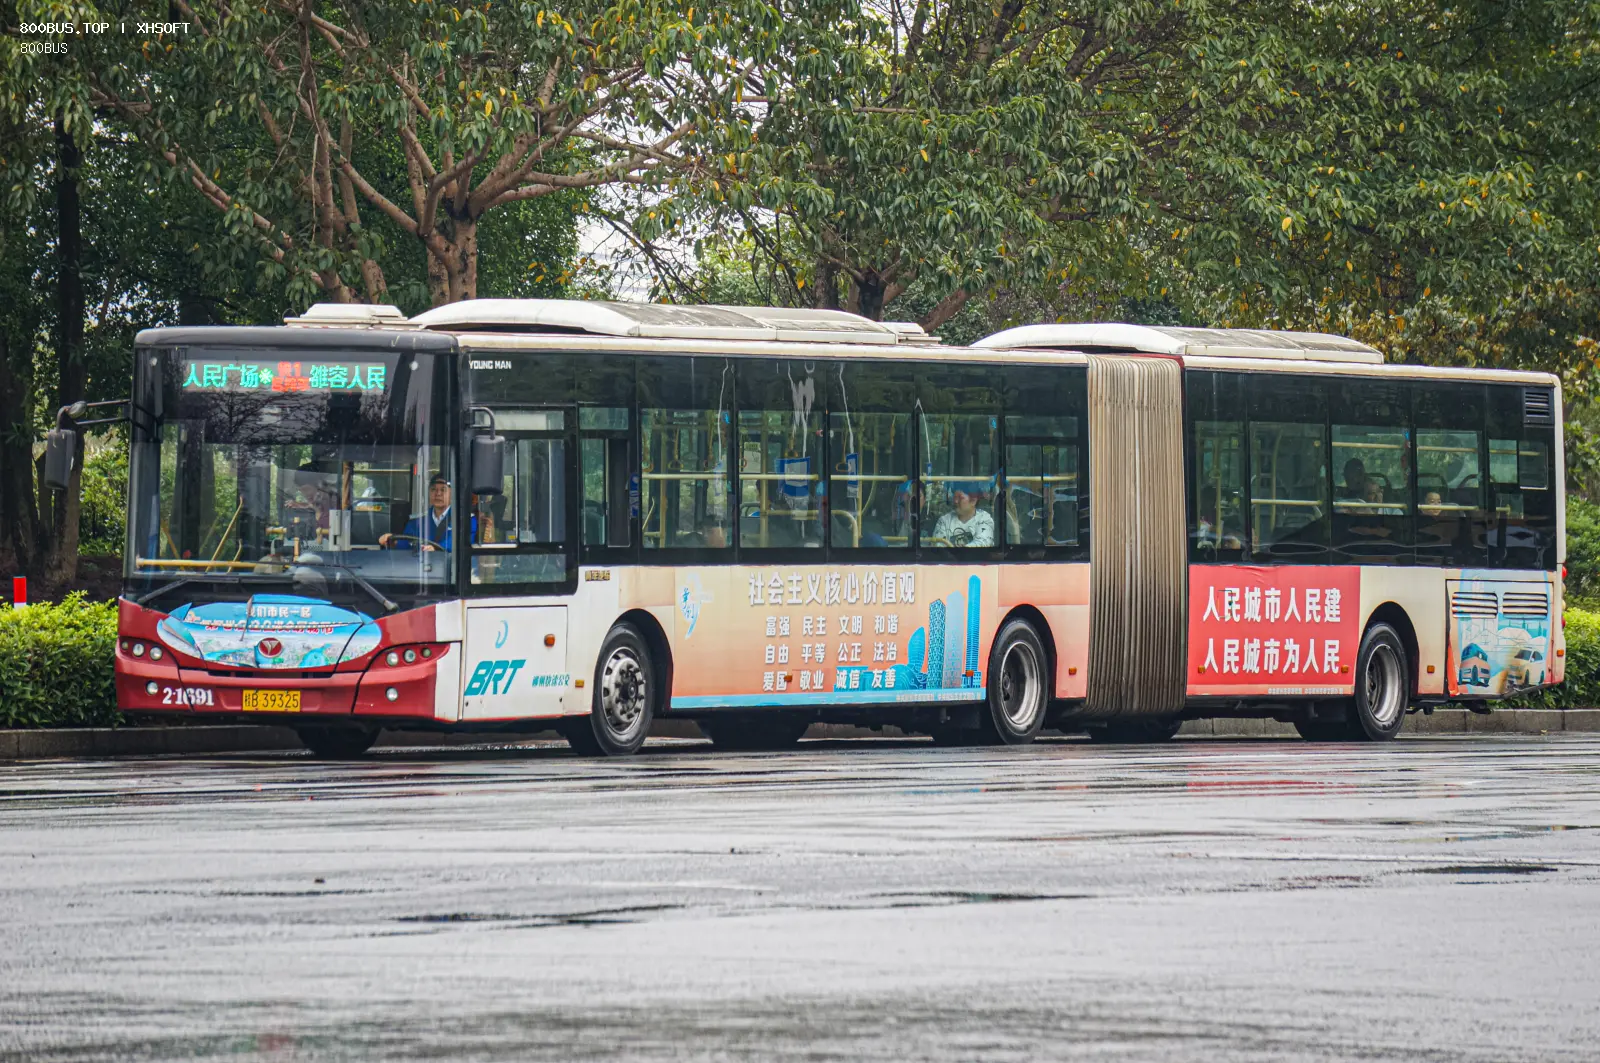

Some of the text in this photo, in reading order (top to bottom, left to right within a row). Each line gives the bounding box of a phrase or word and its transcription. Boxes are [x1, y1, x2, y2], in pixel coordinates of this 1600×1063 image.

[182, 363, 260, 388] 人民广场
[469, 360, 512, 370] YOUNG MAN
[749, 572, 916, 606] 社会主义核心价值观
[1203, 586, 1341, 623] 人民城市人民建
[766, 614, 898, 637] 富强 民主 文明 和谐
[765, 642, 897, 664] 自由 平等 公正 法治
[1203, 638, 1340, 674] 人民城市为人民
[464, 659, 526, 696] BRT
[763, 668, 896, 692] 爱国 敬业 诚信 友善
